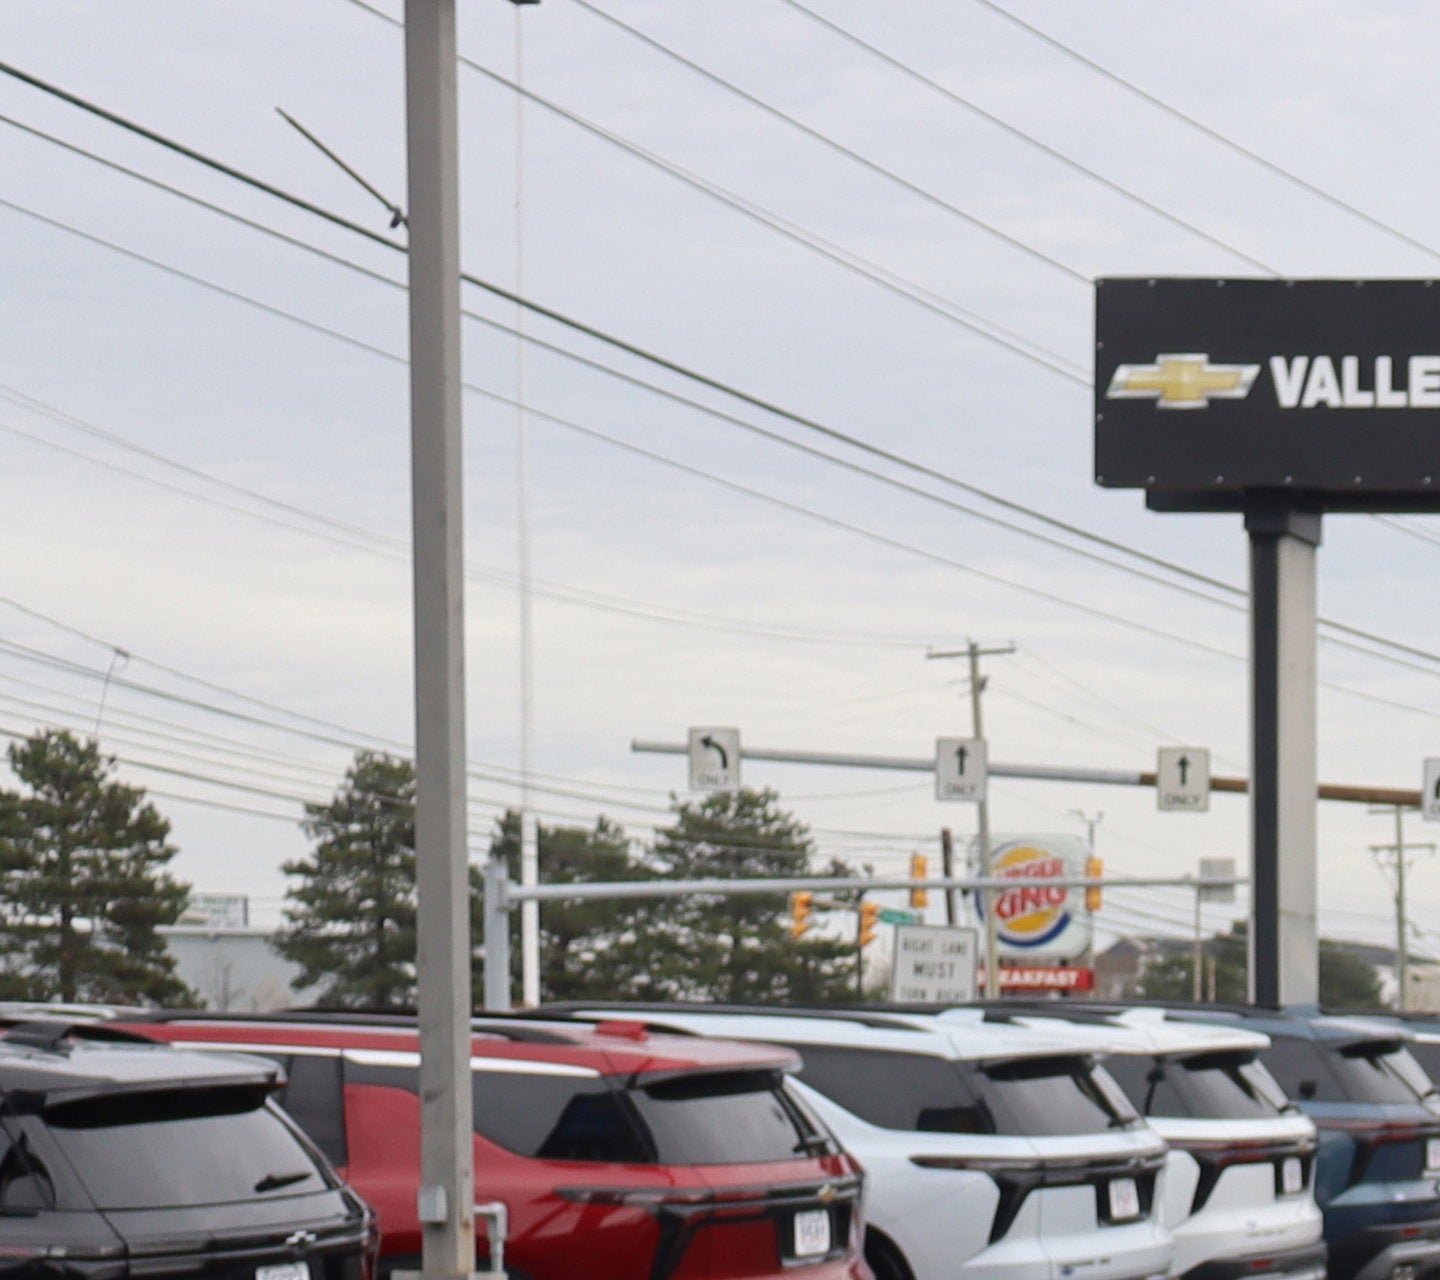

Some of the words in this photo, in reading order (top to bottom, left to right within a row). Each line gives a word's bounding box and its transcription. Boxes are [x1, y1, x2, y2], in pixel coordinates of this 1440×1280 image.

[699, 772, 729, 787] ONLY
[944, 782, 976, 796] ONLY
[1163, 792, 1200, 806] ONLY
[912, 960, 956, 979] MUST
